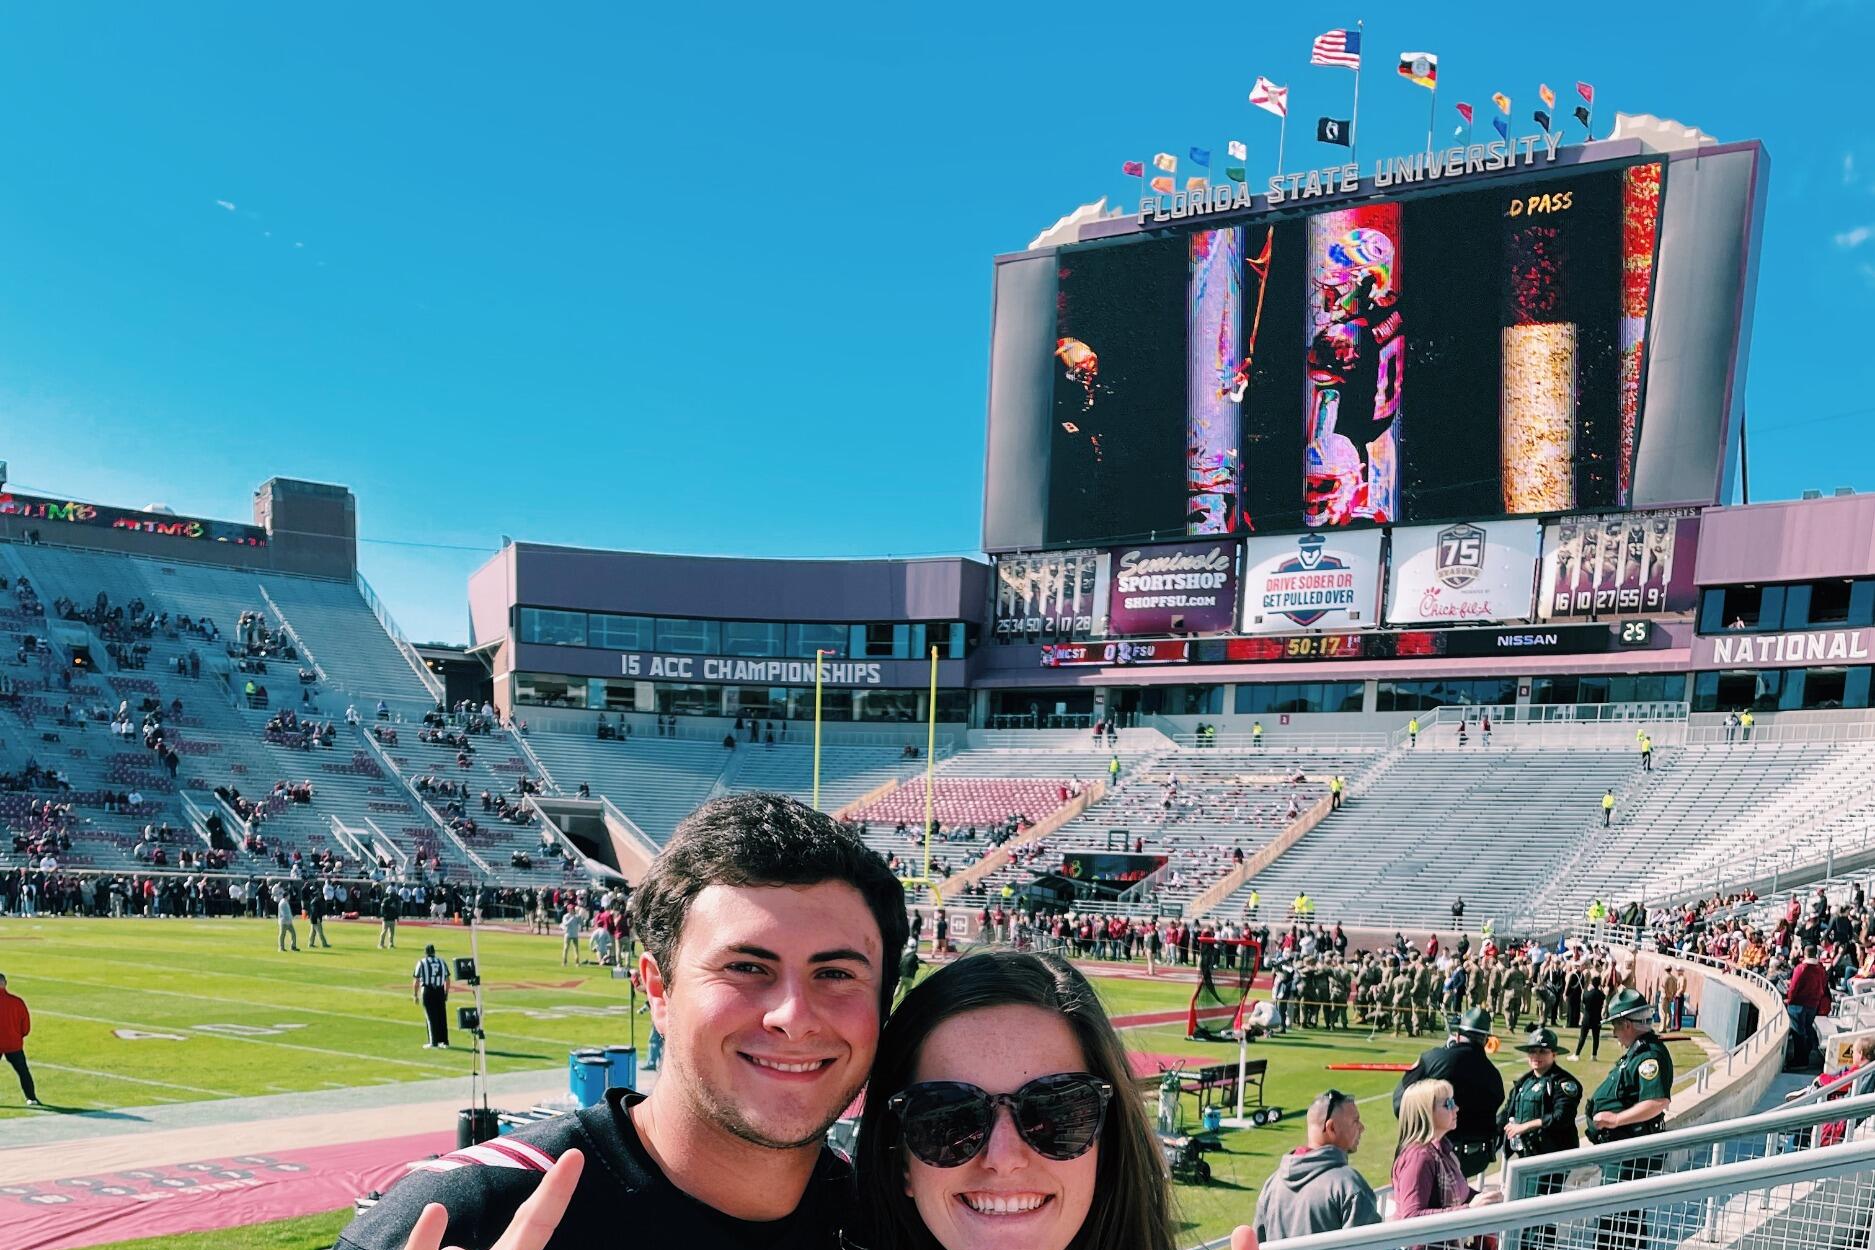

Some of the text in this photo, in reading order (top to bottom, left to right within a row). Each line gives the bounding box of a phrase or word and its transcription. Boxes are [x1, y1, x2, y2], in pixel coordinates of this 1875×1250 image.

[1137, 131, 1564, 225] FLORIDA STATE UNIVERSITY
[1527, 191, 1573, 216] PASS
[1441, 539, 1480, 566] 75
[1117, 547, 1230, 579] Seminole
[1118, 572, 1227, 592] SPORTSHOP
[1266, 573, 1353, 592] DRIVE SOBER OR
[1124, 595, 1216, 609] SHOPFSU.COM
[1263, 589, 1354, 608] GET PULLED OVER
[1420, 592, 1492, 618] Chick-fil-A
[1555, 588, 1659, 611] 16 10 27 55 9
[1011, 619, 1025, 633] 34
[1026, 618, 1041, 632] 50
[1045, 617, 1054, 632] 2
[1061, 617, 1073, 632] 17
[1076, 616, 1092, 631] 28
[1622, 622, 1647, 641] 25
[1287, 637, 1341, 655] 50:17
[1497, 634, 1558, 647] NISSAN
[1713, 631, 1868, 664] NATIONAL
[1104, 644, 1116, 660] 0
[1132, 645, 1156, 657] FSU
[621, 655, 881, 683] 15 ACC CHAMPIONSHIPS
